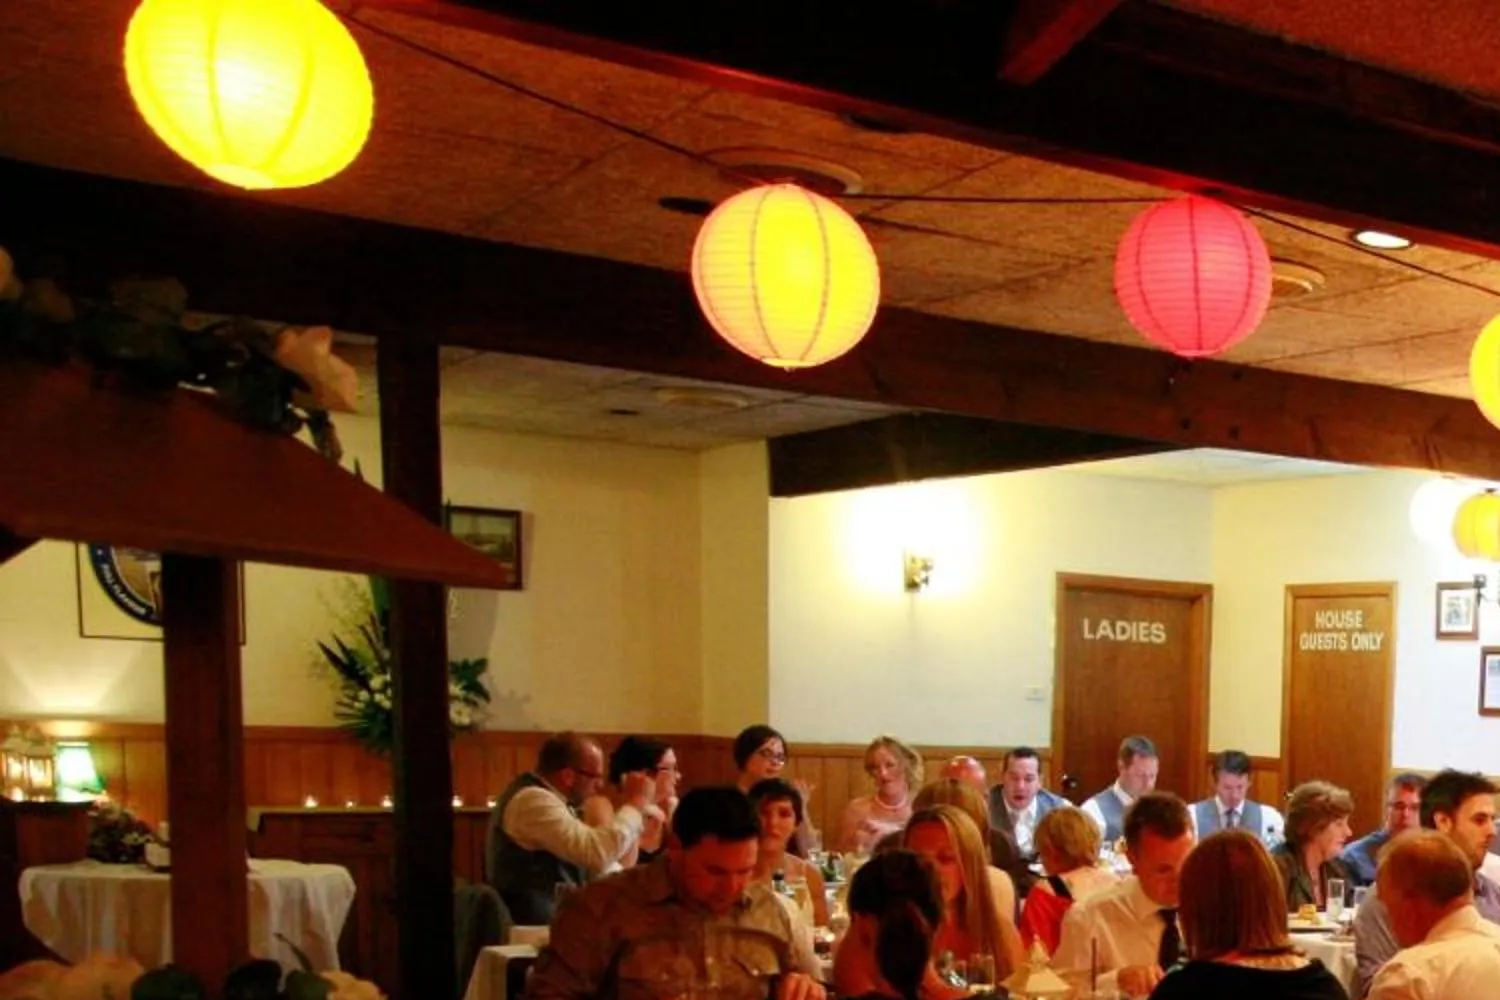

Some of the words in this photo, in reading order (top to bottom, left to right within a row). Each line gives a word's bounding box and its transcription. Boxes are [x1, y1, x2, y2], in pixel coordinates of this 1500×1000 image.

[1315, 609, 1363, 629] HOUSE
[1083, 618, 1167, 643] LADIES
[1299, 631, 1347, 650] GUESTS
[1351, 631, 1385, 651] ONLY
